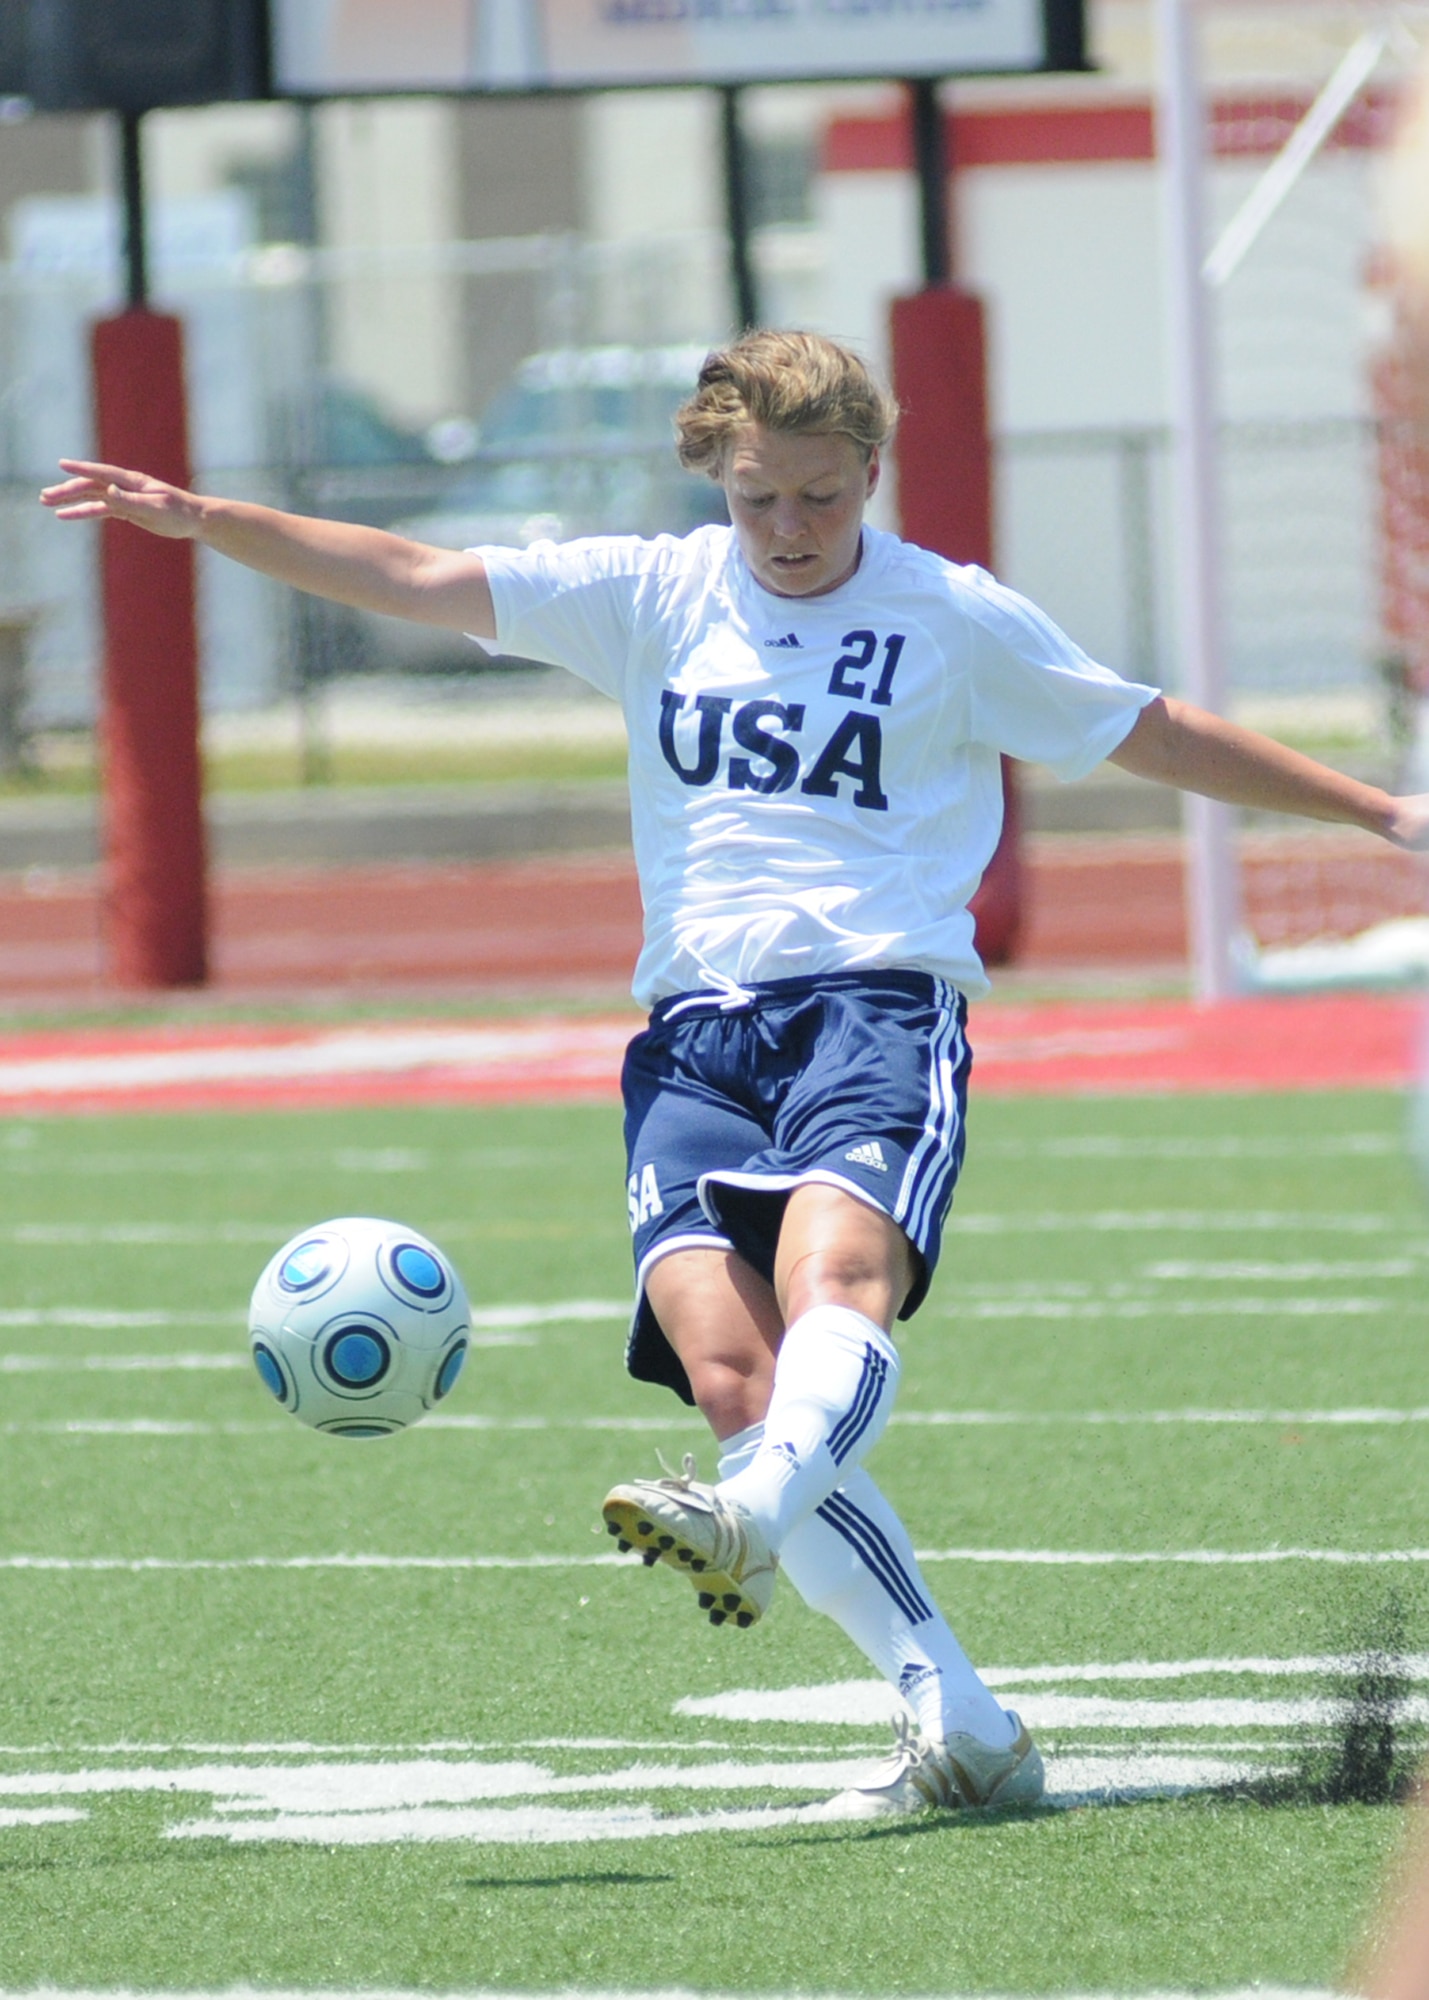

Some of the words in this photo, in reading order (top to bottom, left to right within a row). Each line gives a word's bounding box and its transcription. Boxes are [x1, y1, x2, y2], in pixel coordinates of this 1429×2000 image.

[827, 630, 906, 706] 21
[658, 689, 888, 811] USA
[628, 1163, 664, 1233] SA
[844, 1151, 888, 1173] adidas
